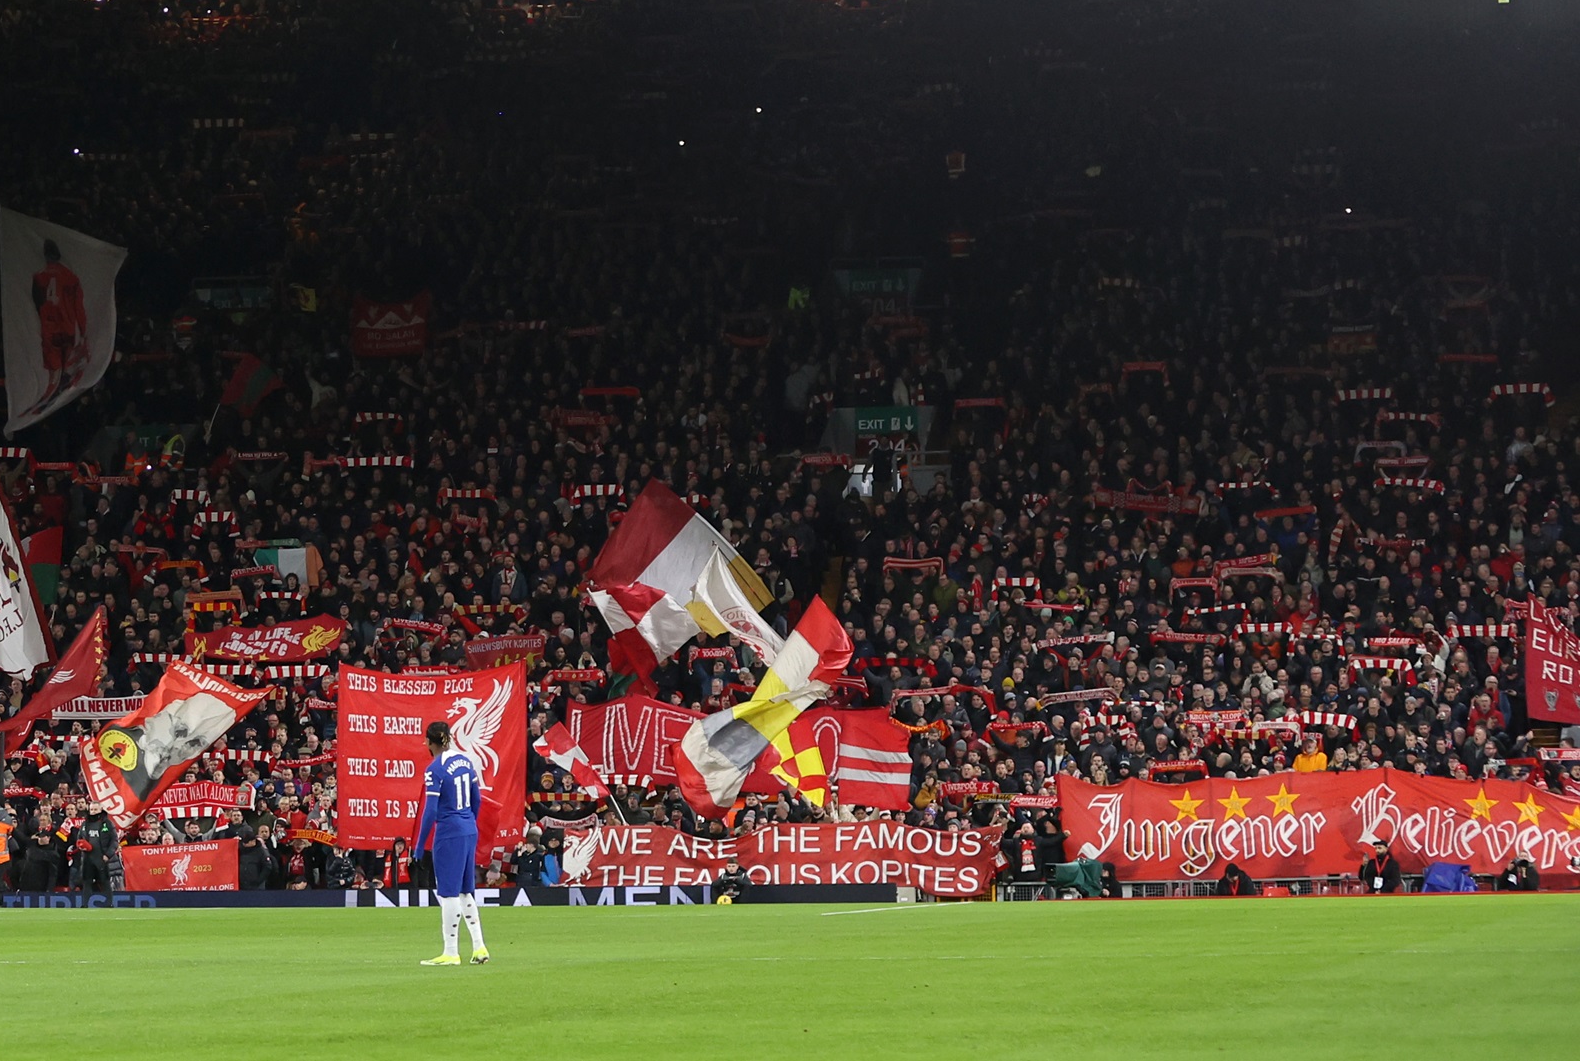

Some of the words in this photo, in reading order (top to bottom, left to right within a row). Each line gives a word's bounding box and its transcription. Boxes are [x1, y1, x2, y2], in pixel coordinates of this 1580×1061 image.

[858, 420, 884, 430] EXIT
[269, 641, 288, 656] FC
[467, 641, 512, 654] SHREWSBURY
[513, 639, 542, 649] KOPITES
[1542, 660, 1573, 685] RO
[347, 672, 377, 692] THIS
[383, 678, 436, 695] BLESSED
[443, 678, 473, 695] PLOT
[88, 699, 124, 712] NEVER
[347, 714, 377, 734] THIS
[383, 717, 422, 735] EARTH
[287, 754, 333, 765] LIVERPOOL
[347, 757, 377, 777] THIS
[384, 760, 415, 778] LAND
[453, 773, 471, 810] 11
[944, 782, 978, 791] LIVERPOOL
[981, 782, 991, 790] FC
[162, 788, 188, 806] NEVER
[189, 787, 208, 802] WALK
[209, 788, 234, 803] ALONE
[348, 799, 378, 818] THIS
[385, 800, 401, 818] IS
[1077, 793, 1326, 876] Jurgener
[1351, 783, 1580, 873] Believers
[142, 847, 165, 855] TONY
[167, 843, 218, 854] HEFFERNAN
[597, 826, 653, 856] WE
[667, 832, 740, 860] ARE
[757, 826, 821, 854] THE
[835, 823, 982, 857] FAMOUS
[149, 867, 167, 875] 1967
[193, 865, 212, 873] 2023
[597, 864, 668, 887] THE
[673, 863, 823, 886] FAOUS
[831, 860, 979, 893] KOPITES
[569, 886, 711, 906] MEN
